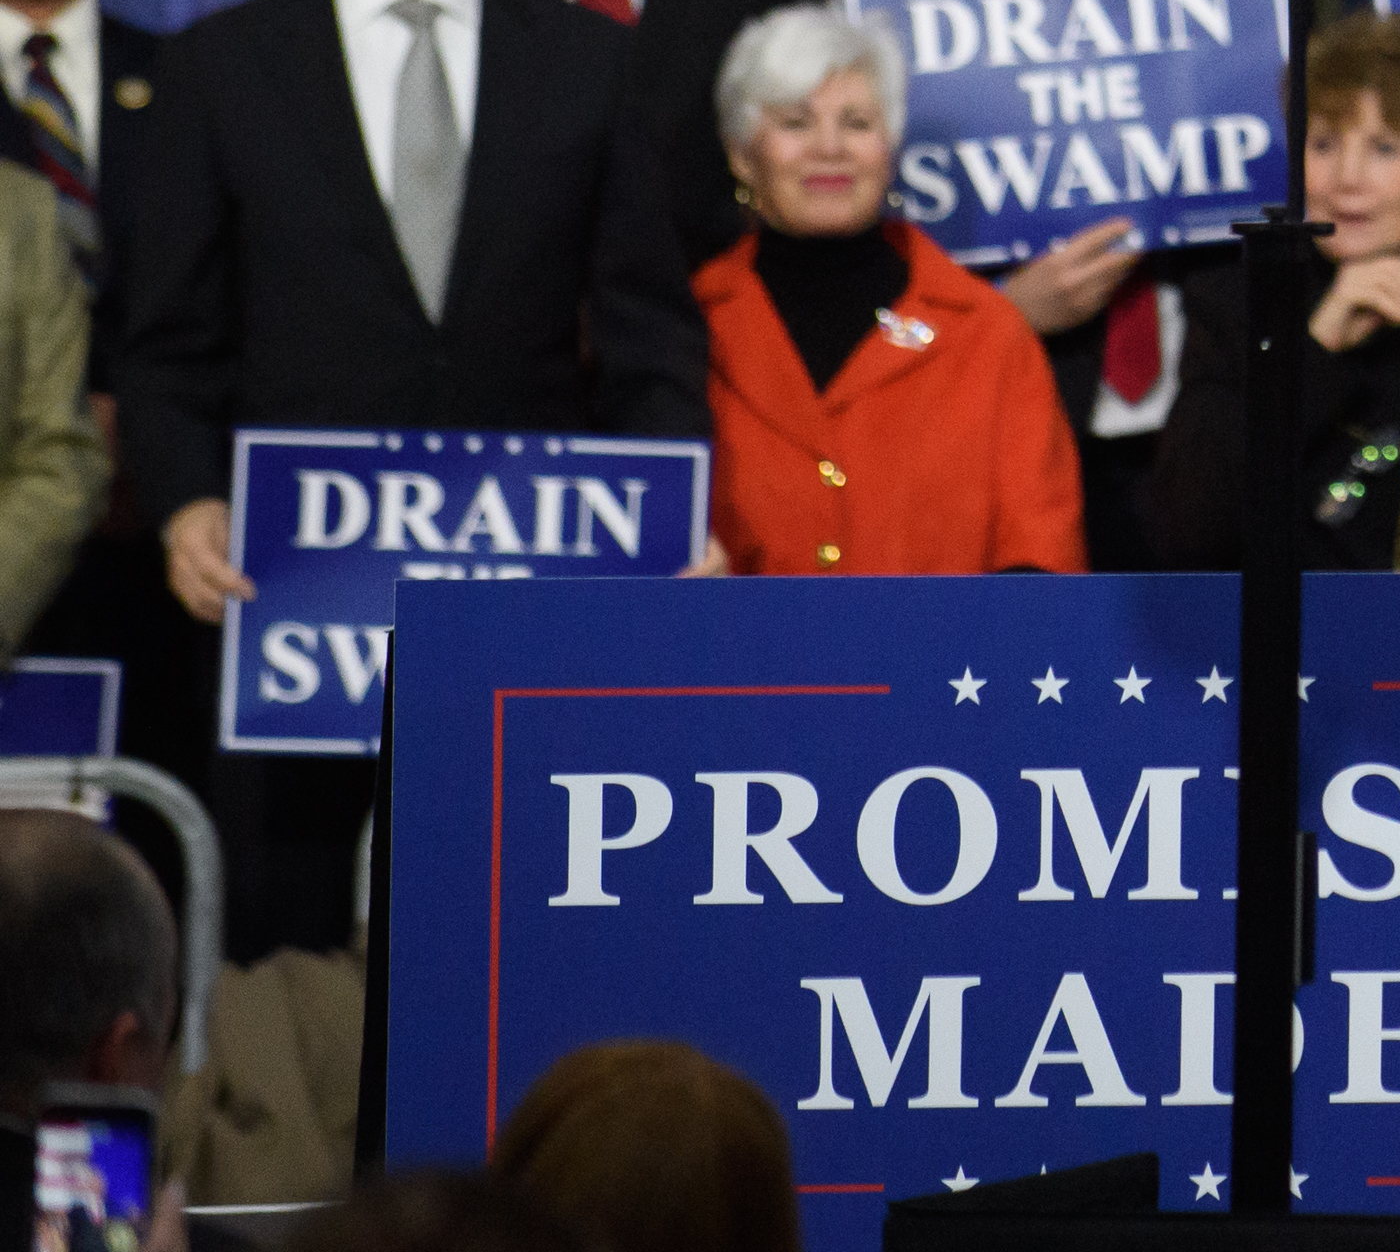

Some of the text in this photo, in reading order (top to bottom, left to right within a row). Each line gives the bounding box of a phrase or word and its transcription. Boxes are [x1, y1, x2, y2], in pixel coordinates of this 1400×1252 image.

[1018, 63, 1145, 127] THE
[900, 113, 1272, 223] SWAMP
[295, 468, 650, 559] DRAIN
